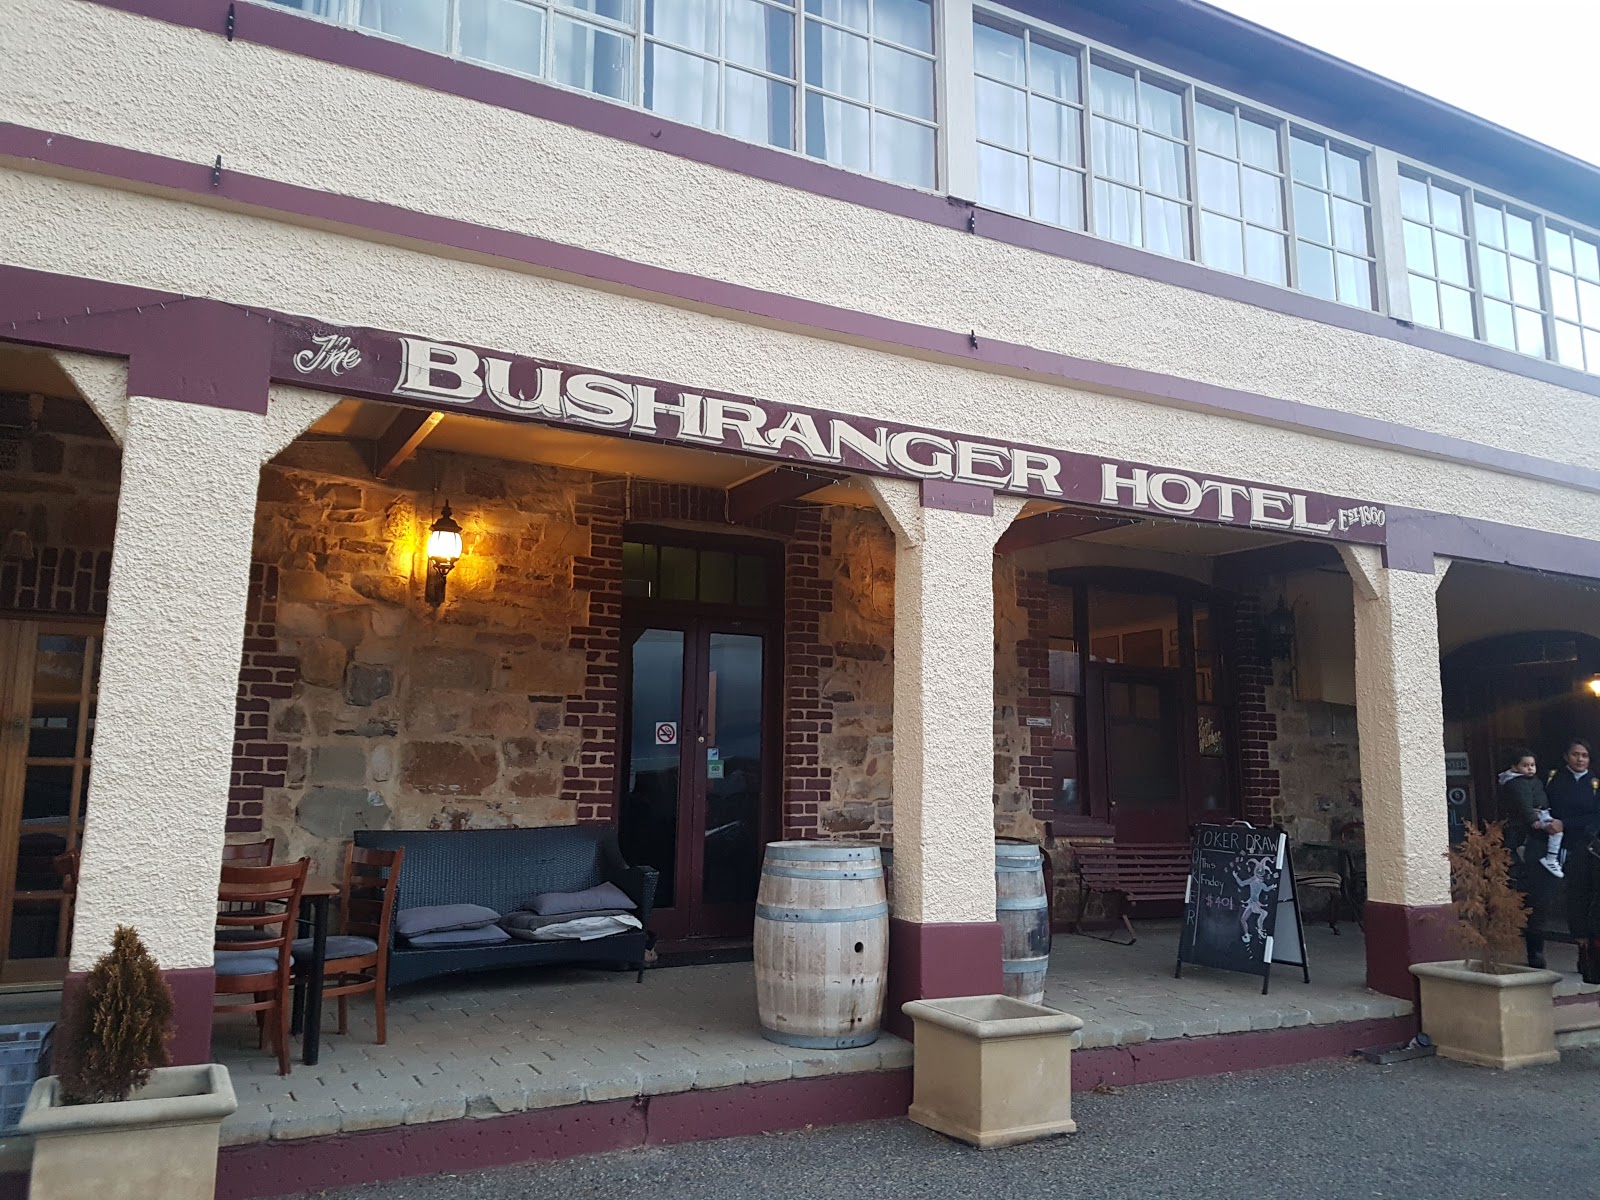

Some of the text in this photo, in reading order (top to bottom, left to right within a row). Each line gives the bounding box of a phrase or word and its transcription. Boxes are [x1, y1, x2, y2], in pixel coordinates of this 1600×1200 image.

[293, 333, 362, 376] The
[391, 337, 1065, 496] BUSHRANGER
[1099, 463, 1336, 535] HOTEL
[1359, 505, 1386, 528] 1860
[1245, 834, 1279, 851] DRAW
[1201, 857, 1216, 869] This
[1200, 873, 1225, 895] Friday
